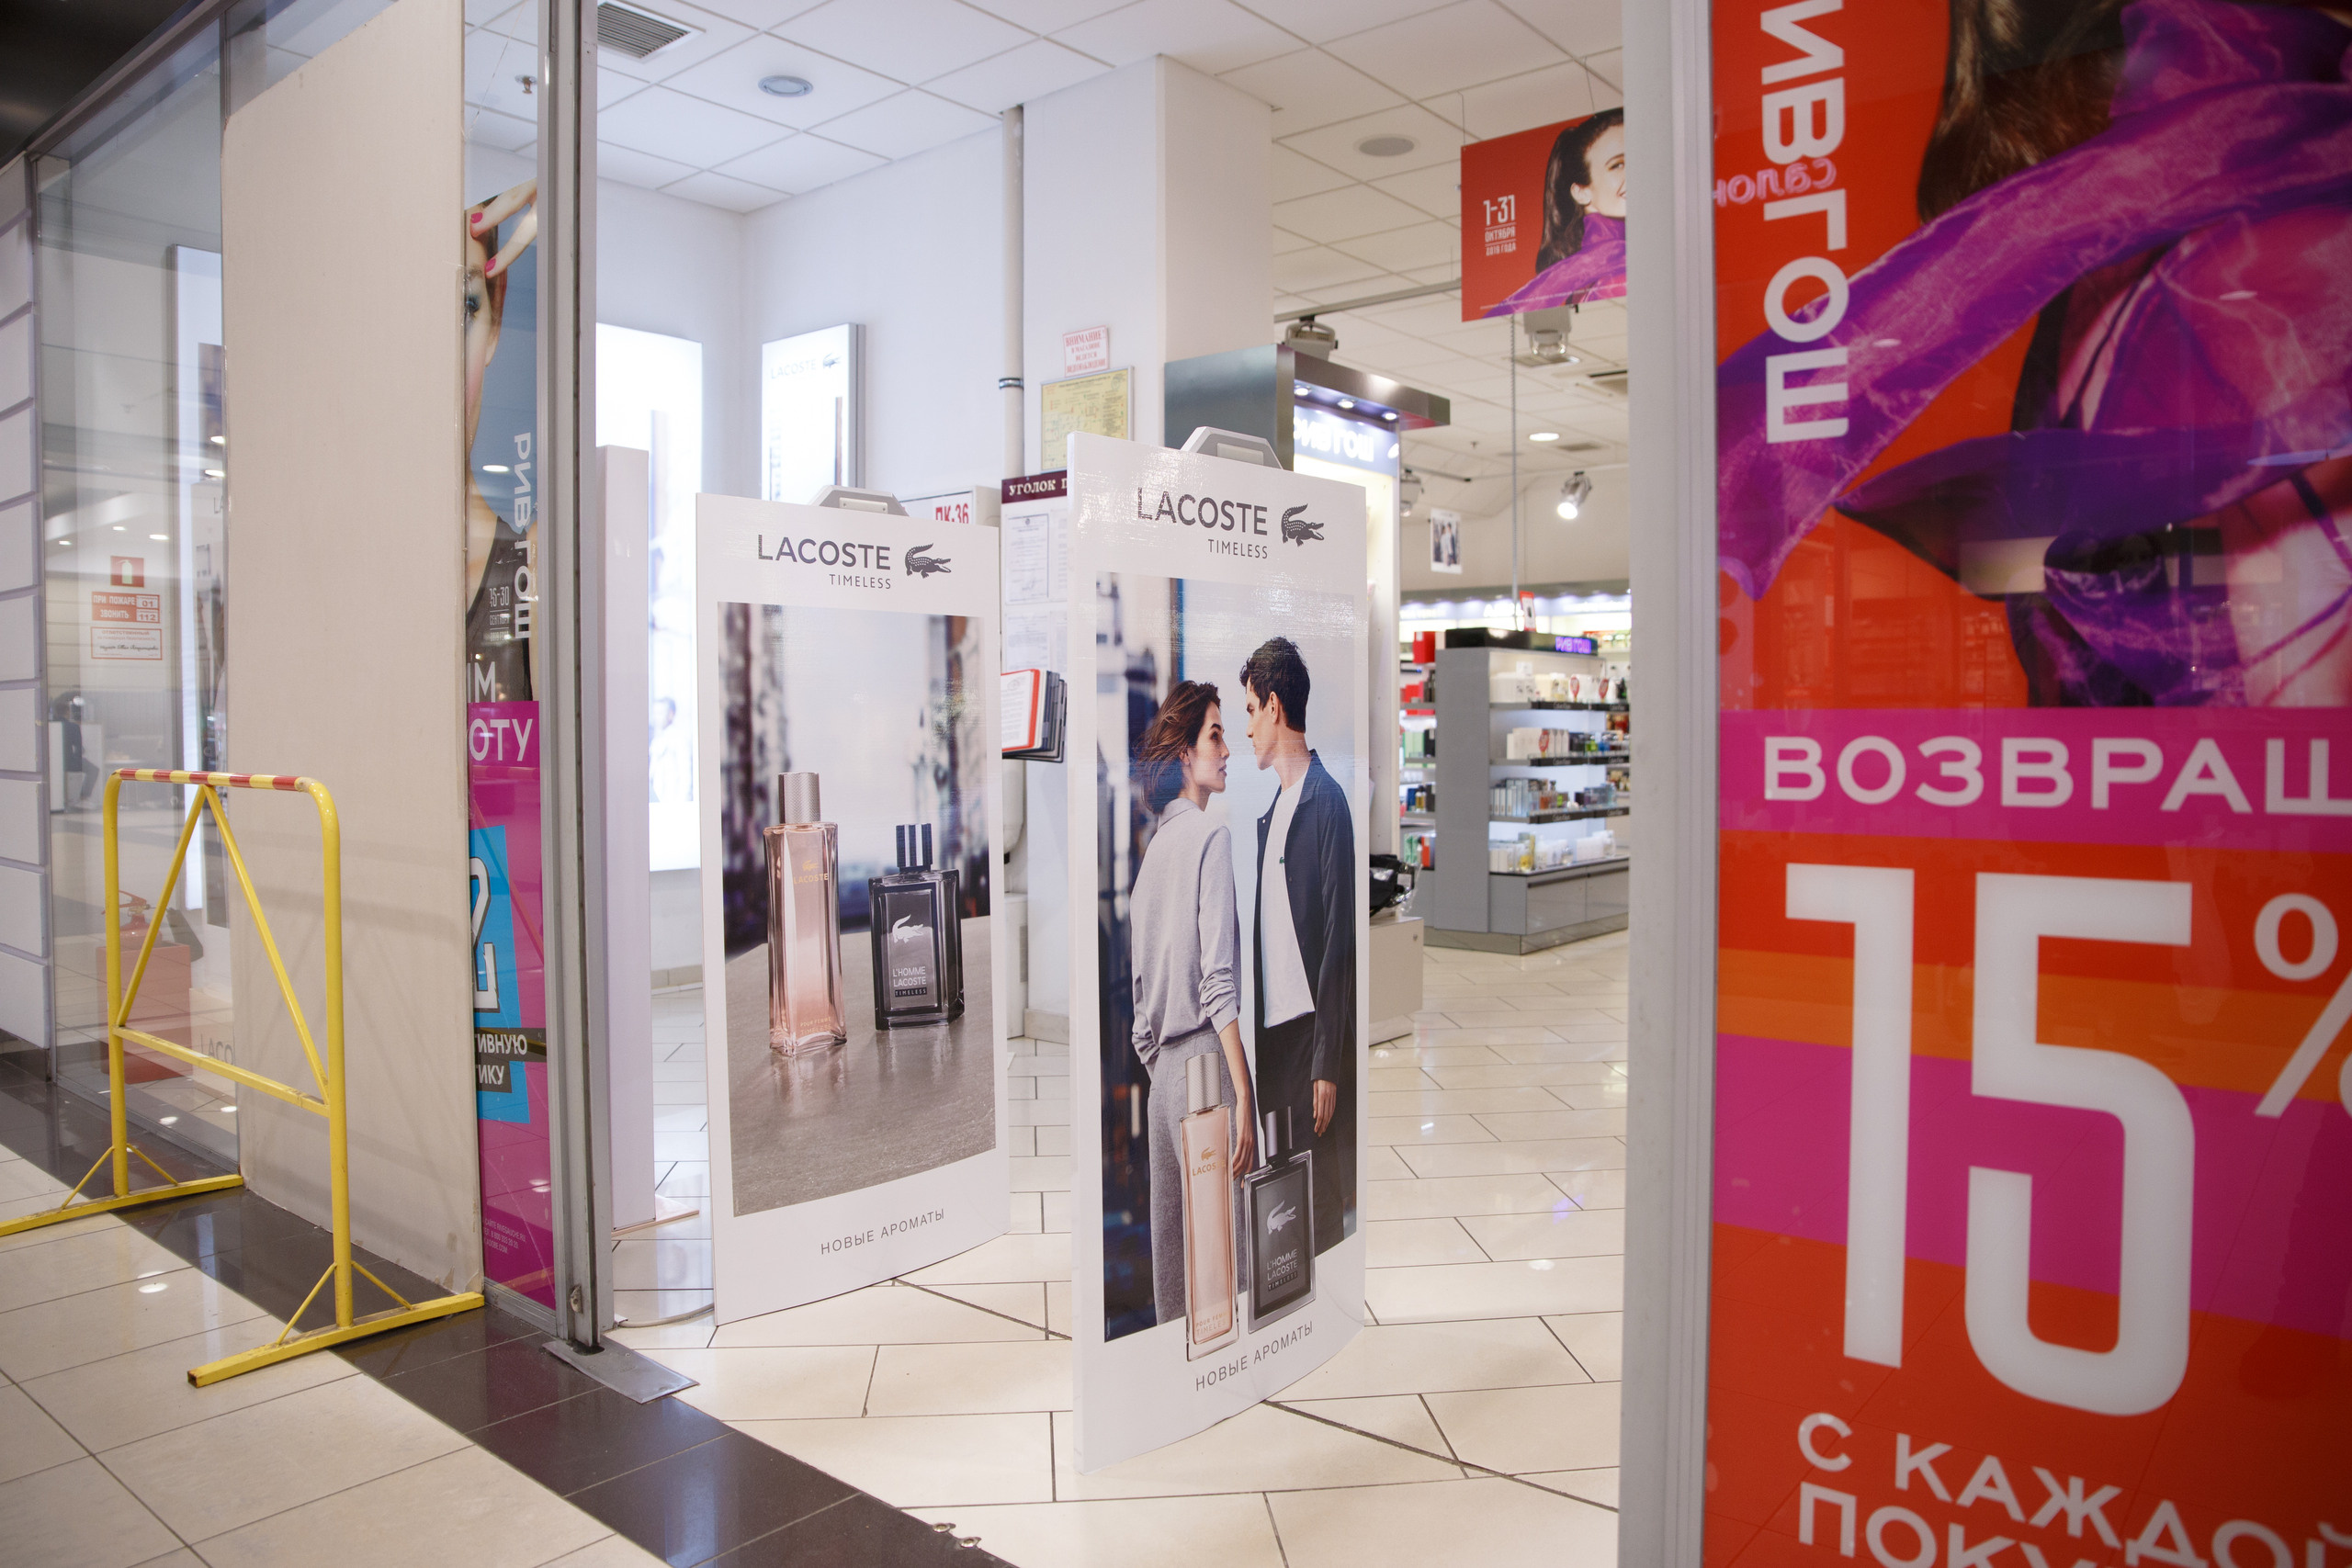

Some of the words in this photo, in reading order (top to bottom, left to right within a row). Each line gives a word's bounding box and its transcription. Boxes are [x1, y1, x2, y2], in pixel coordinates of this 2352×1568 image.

[1483, 194, 1516, 226] 1-31
[1485, 226, 1516, 243] ОКТЯБРЯ
[1763, 188, 1850, 446] ГОШ
[514, 432, 531, 528] РИВ
[1009, 479, 1057, 496] УГОЛОК
[1136, 486, 1268, 536] LACOSTE
[756, 534, 891, 571] LACOSTE
[1207, 538, 1269, 559] TIMELESS
[514, 539, 532, 639] ГОШ
[829, 573, 892, 590] TIMELESS
[93, 595, 107, 604] ПРИ
[109, 595, 136, 605] ПОЖАРЕ
[489, 586, 510, 607] 15-30
[99, 609, 130, 618] ЗВОНИТЬ
[469, 718, 533, 761] ОТУ
[793, 873, 829, 885] LACOSTE
[892, 965, 926, 977] L'HOMME
[893, 976, 927, 987] LACOSTE
[895, 988, 926, 997] TIMELESS
[475, 1034, 528, 1055] ИВНУЮ
[475, 1064, 505, 1086] ИКУ
[1192, 1160, 1226, 1177] LACOSTE
[820, 1229, 875, 1256] НОВЫЕ
[880, 1208, 945, 1240] АРОМАТЫ
[1266, 1248, 1298, 1270] L'HOMME
[1267, 1259, 1298, 1281] LACOSTE
[1268, 1271, 1297, 1291] TIMELESS
[1195, 1317, 1211, 1328] POUR
[1195, 1355, 1248, 1391] НОВЫЕ
[1253, 1320, 1313, 1365] АРОМАТЫ
[1797, 1412, 1853, 1472] С
